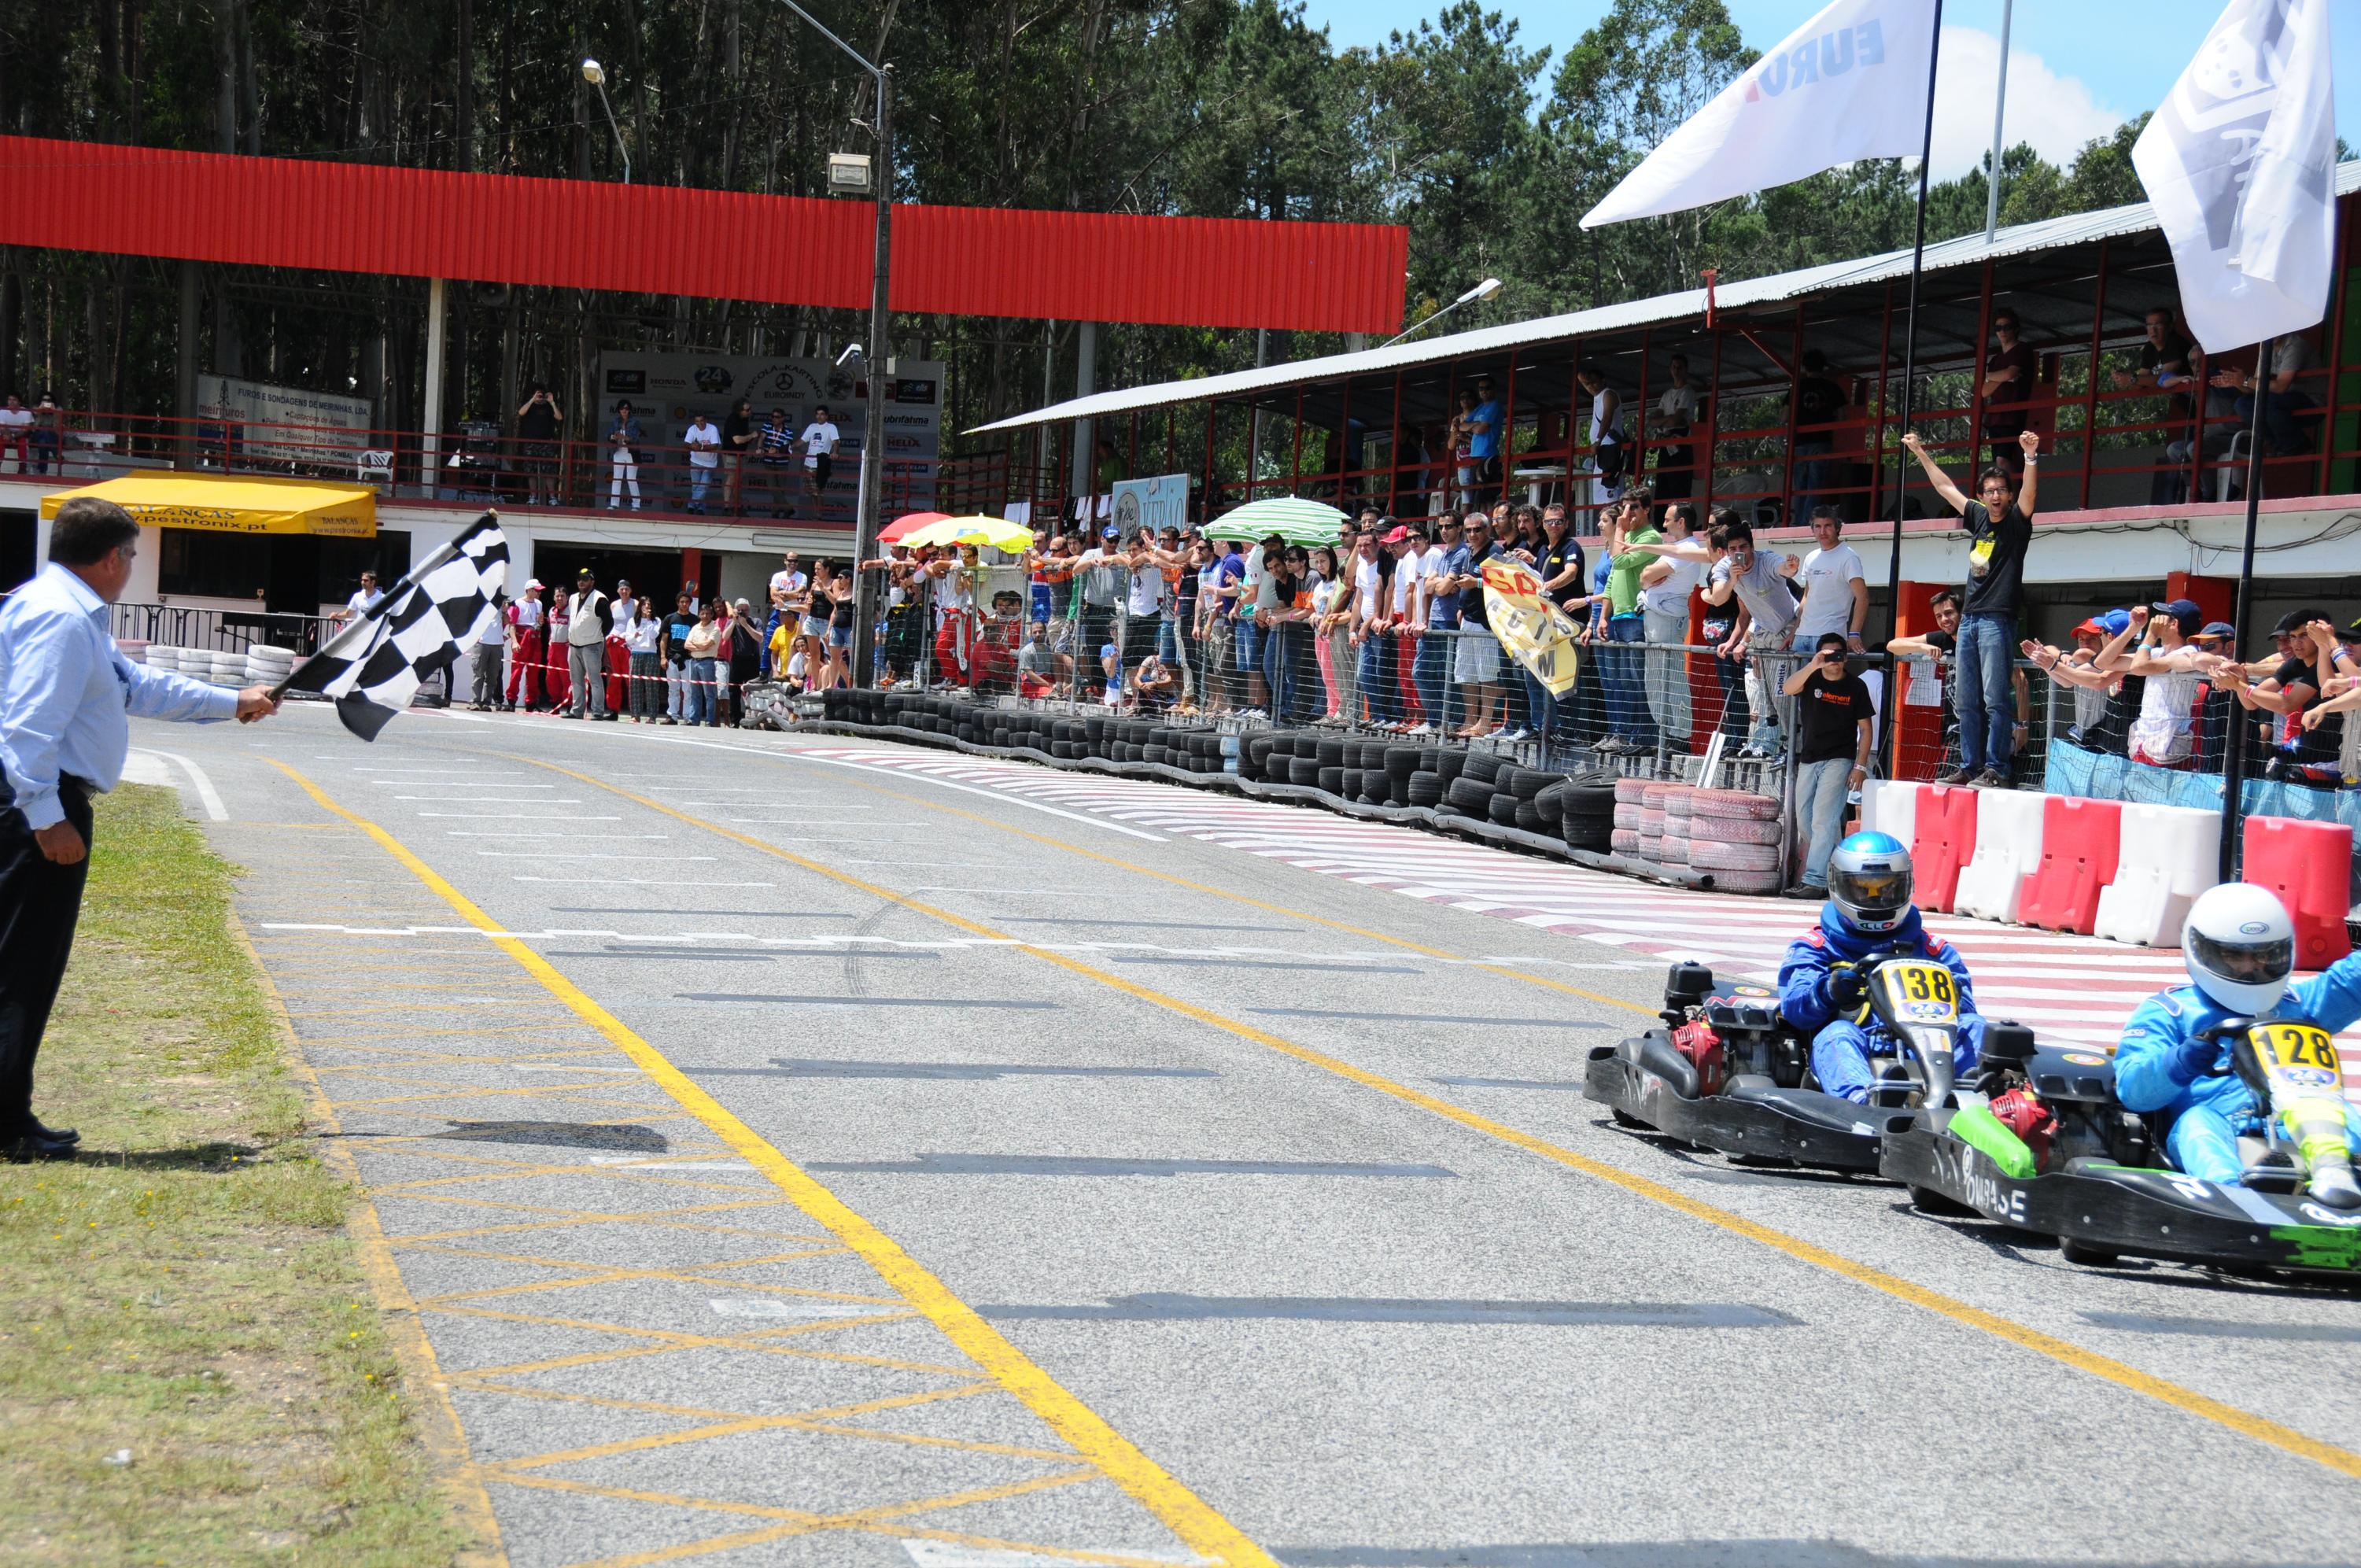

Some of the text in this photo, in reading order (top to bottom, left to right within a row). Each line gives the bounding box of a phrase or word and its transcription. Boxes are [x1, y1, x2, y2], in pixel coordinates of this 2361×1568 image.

[700, 367, 723, 382] 24
[744, 365, 777, 398] ESCOLA
[784, 364, 823, 399] KARTING
[238, 388, 260, 400] FUROS
[267, 393, 308, 408] SONDAGENS
[308, 400, 317, 408] DE
[884, 415, 929, 425] ubrifatima
[286, 431, 313, 442] Qualquer
[887, 438, 920, 447] HELIX
[330, 450, 353, 459] POMBAL
[1777, 661, 1787, 695] Deloitte.
[1822, 692, 1851, 703] element
[1891, 968, 1951, 1003] 138
[2256, 1028, 2335, 1069] 128
